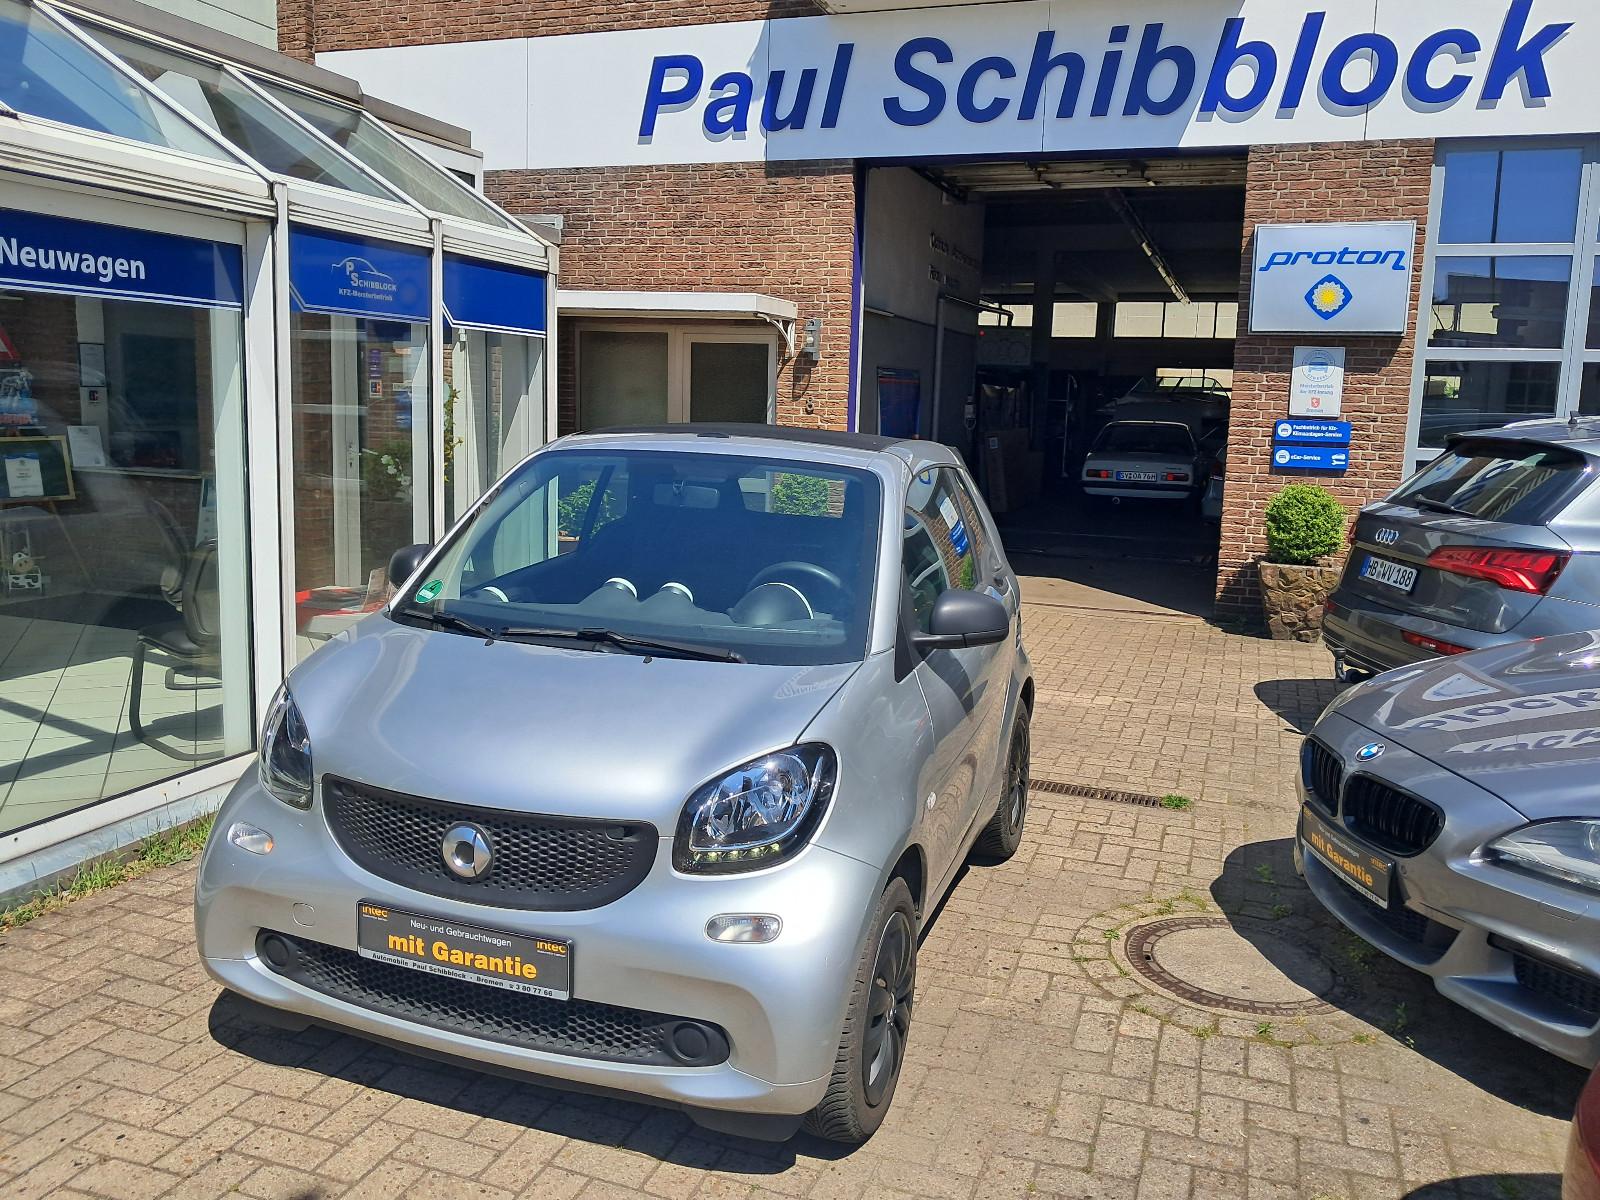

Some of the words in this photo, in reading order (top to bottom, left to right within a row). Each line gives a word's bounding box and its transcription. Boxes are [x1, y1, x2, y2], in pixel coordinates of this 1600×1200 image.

[638, 43, 854, 138] Paul
[882, 0, 1575, 127] Schibblock
[0, 236, 146, 282] Neuwagen
[1258, 246, 1406, 272] proton
[1311, 831, 1325, 851] mit
[1326, 843, 1374, 887] Garantie
[362, 905, 388, 918] intec
[410, 919, 428, 929] Neu-
[430, 925, 444, 934] und
[446, 926, 512, 948] Gebrauchtwagen
[536, 941, 567, 953] intec
[372, 952, 409, 967] Automobile
[412, 961, 427, 970] Paul
[428, 965, 466, 980] Schibblock
[476, 975, 504, 987] Bremen
[387, 934, 425, 957] mit
[432, 941, 538, 980] Garantie
